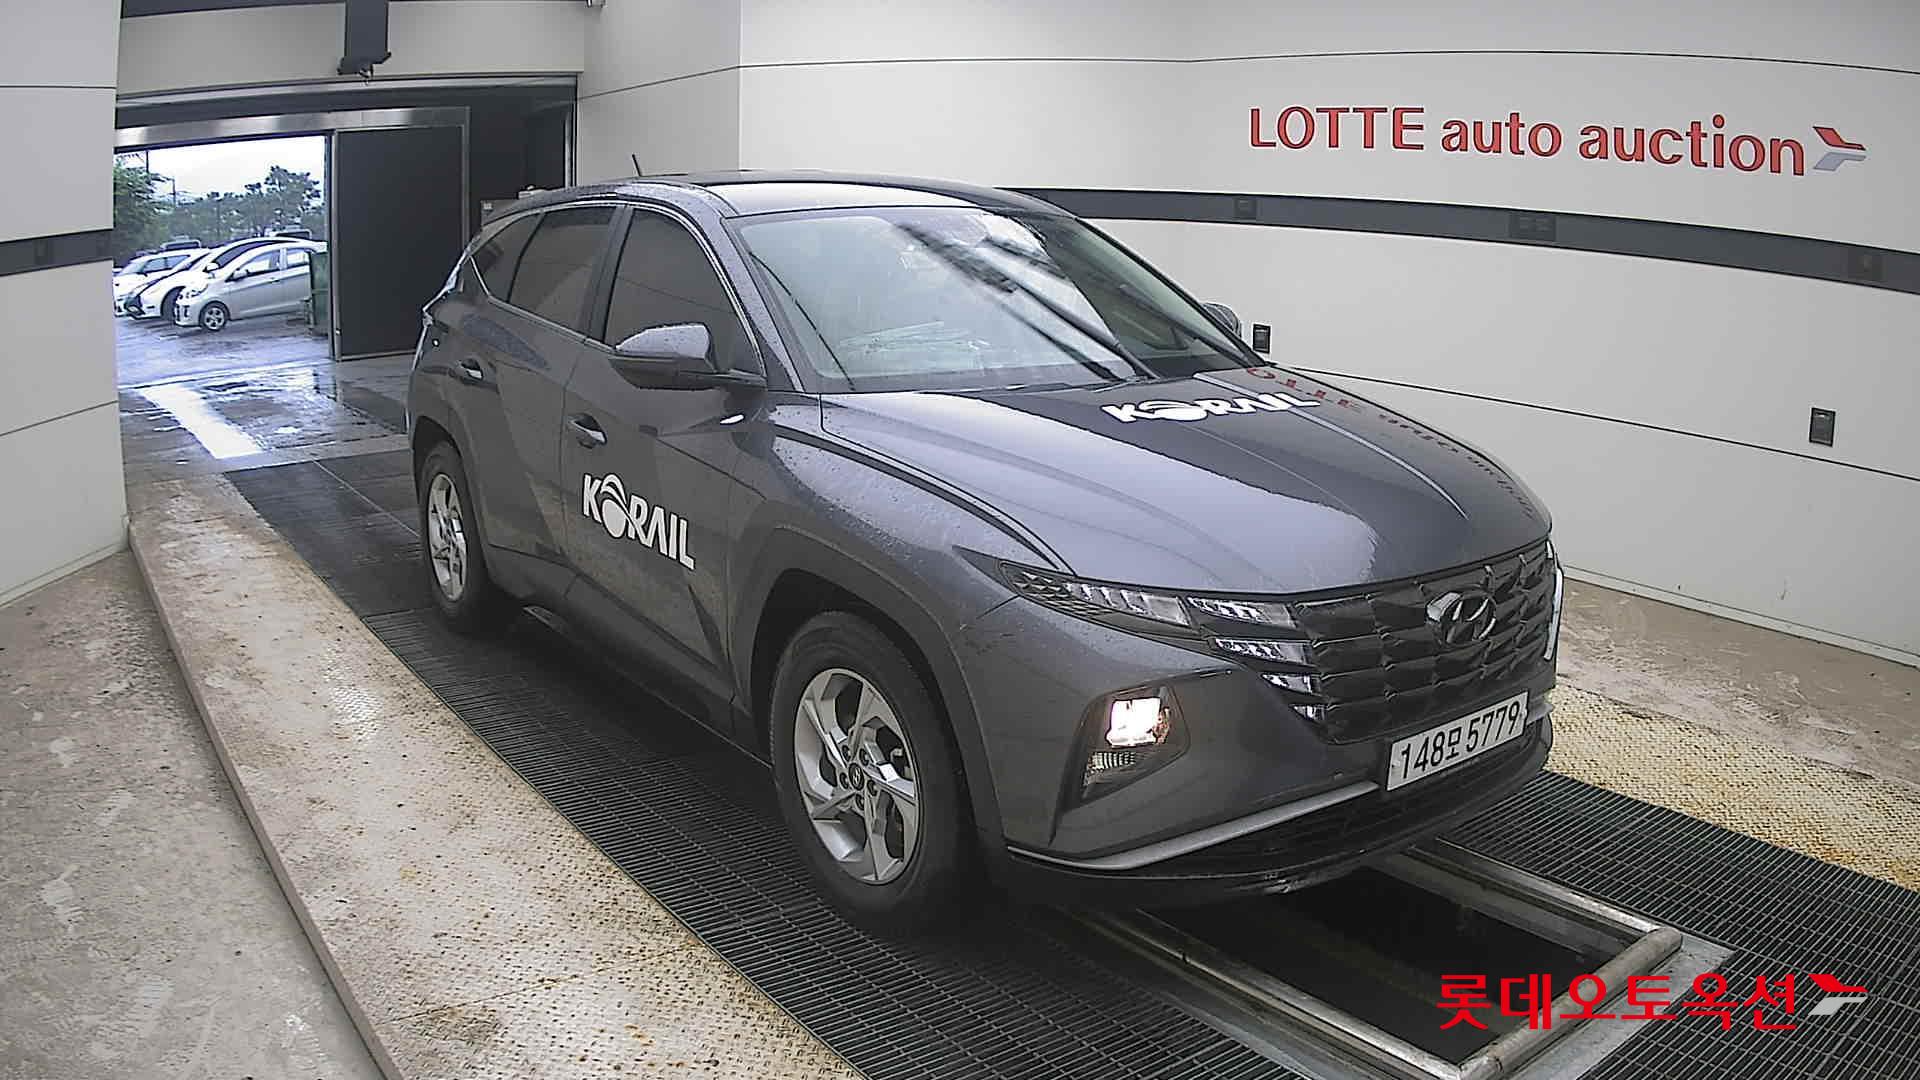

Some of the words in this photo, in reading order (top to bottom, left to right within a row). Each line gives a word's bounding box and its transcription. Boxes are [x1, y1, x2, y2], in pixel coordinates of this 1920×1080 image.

[1249, 106, 1426, 150] LOTTE
[1441, 112, 1563, 157] auto
[1579, 114, 1806, 176] auction
[1102, 392, 1321, 423] KORAIL
[582, 473, 696, 571] KORAIL
